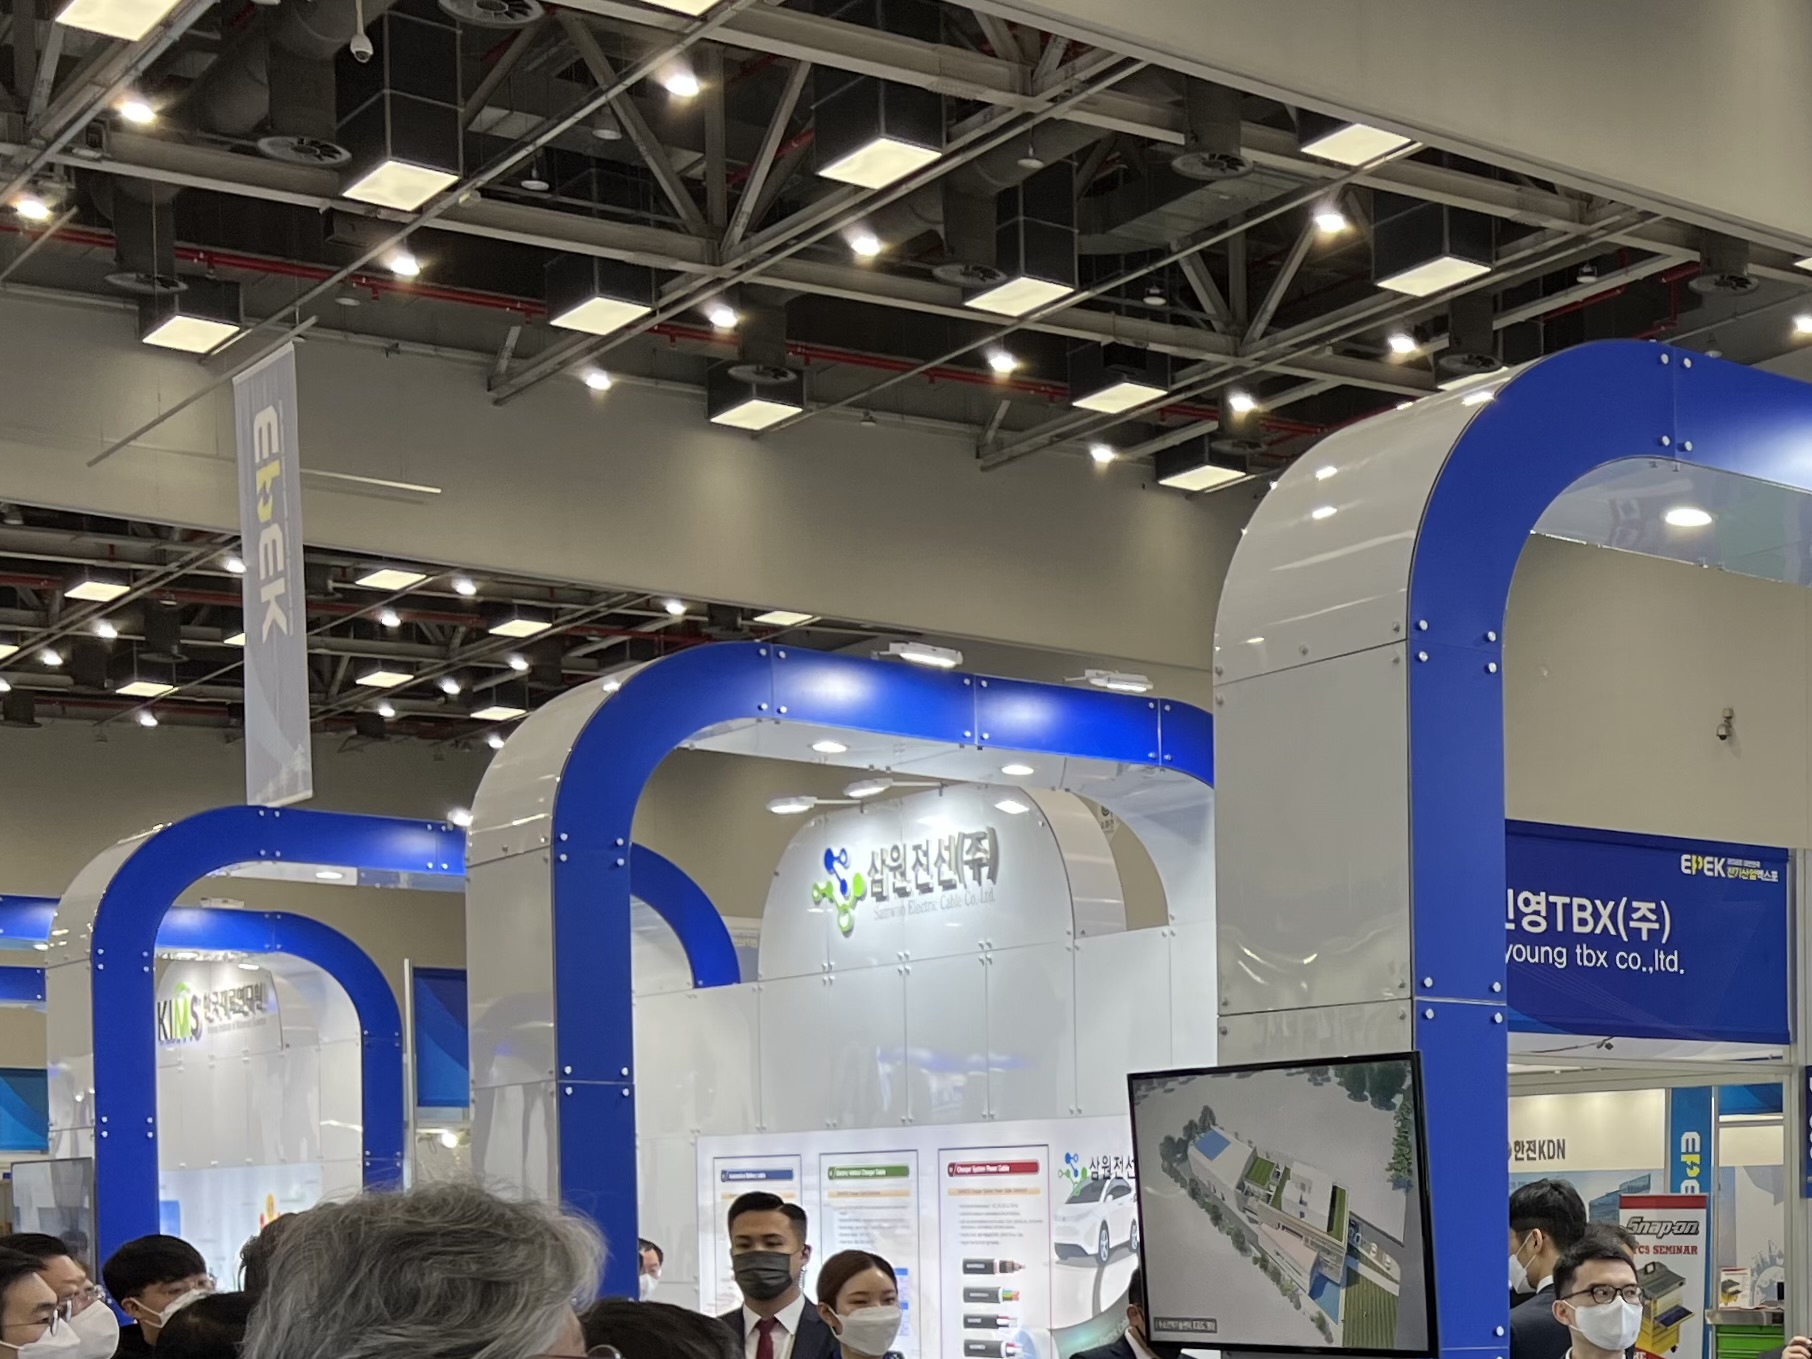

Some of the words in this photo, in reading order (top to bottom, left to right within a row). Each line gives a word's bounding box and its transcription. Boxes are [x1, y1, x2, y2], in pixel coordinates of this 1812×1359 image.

[867, 826, 1000, 903] 삼원전선(주)
[1575, 943, 1609, 969] tbx
[1615, 949, 1685, 975] co.,ltd.
[157, 993, 202, 1042] KIMS
[1513, 1138, 1566, 1162] 한전KDN
[1626, 1216, 1700, 1239] Snap-on
[1652, 1245, 1698, 1255] SEMINAR
